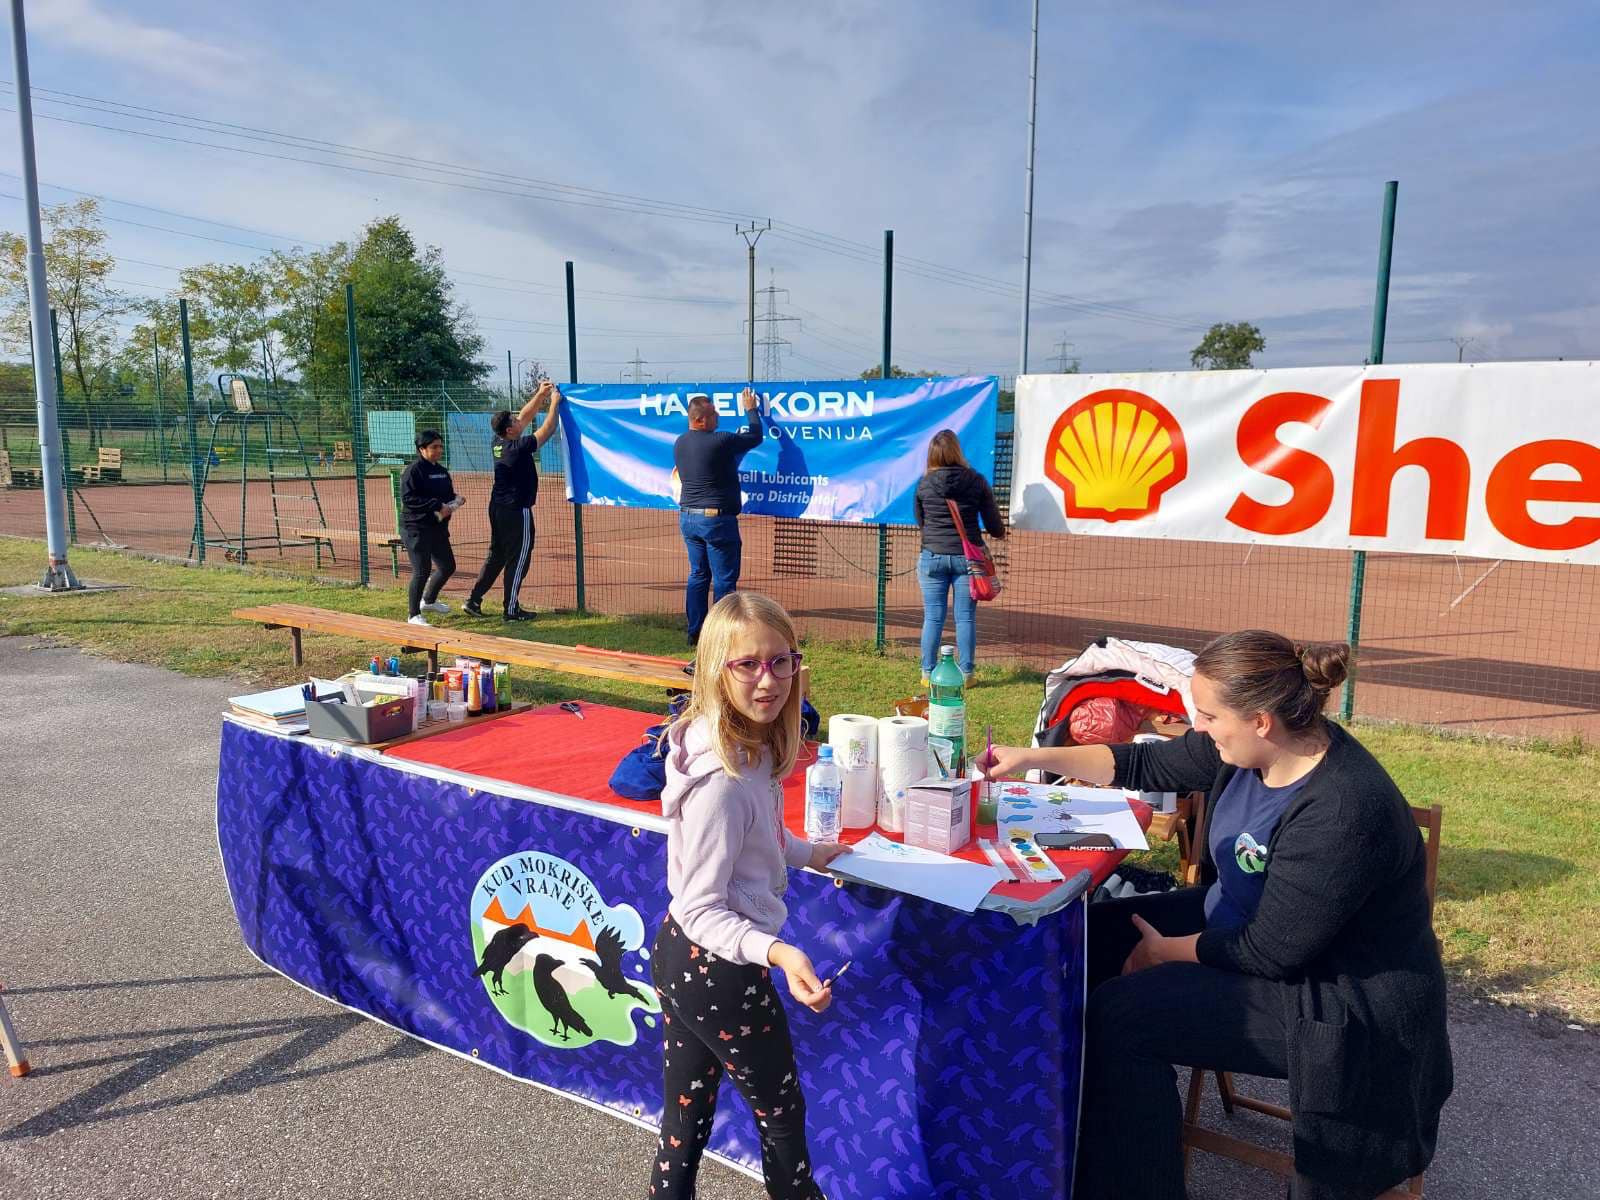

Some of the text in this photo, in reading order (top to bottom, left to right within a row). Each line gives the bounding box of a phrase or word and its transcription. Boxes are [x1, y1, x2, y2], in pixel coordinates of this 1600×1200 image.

[640, 391, 874, 418] HAEKORN
[740, 425, 873, 440] SOVENIJA
[762, 471, 829, 486] Lubricants
[482, 856, 605, 926] KUD MOKRIŠKE
[510, 876, 576, 910] VRANE
